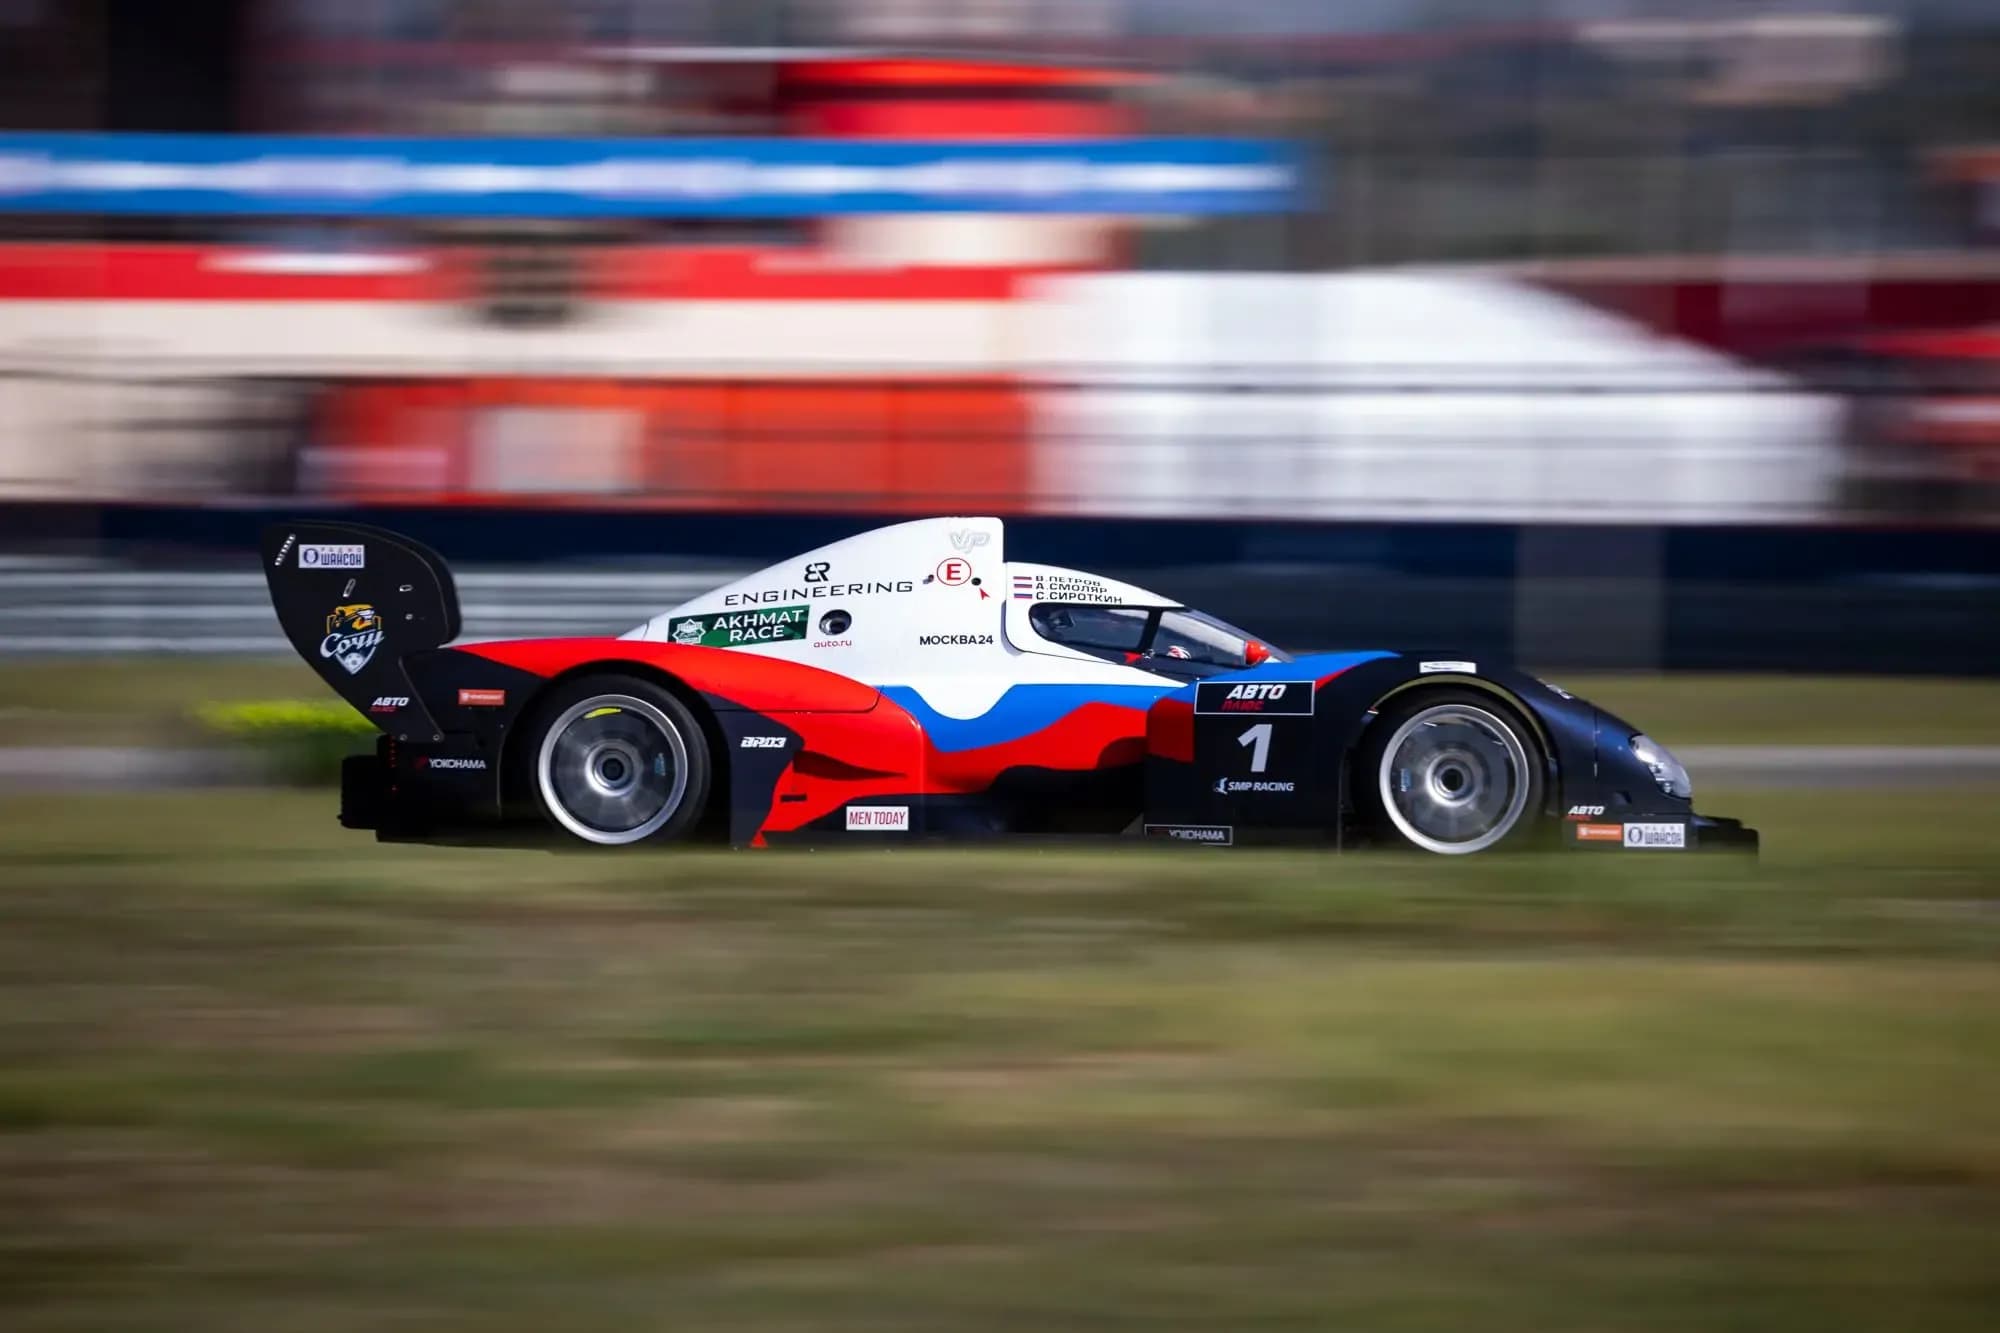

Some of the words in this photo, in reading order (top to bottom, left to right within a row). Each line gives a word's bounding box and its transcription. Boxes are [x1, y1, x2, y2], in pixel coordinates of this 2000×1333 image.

[321, 553, 362, 566] ШАНСОН
[946, 563, 962, 580] E
[725, 581, 913, 606] ENGINEERING
[1035, 583, 1108, 593] А.СМОЛЯР
[1035, 592, 1123, 604] С.СИРОТКИН
[713, 609, 804, 630] AKHMAT
[729, 625, 785, 642] RACE
[919, 635, 994, 645] МОСКВА24
[320, 630, 384, 658] Сочи
[813, 640, 852, 648] auto.ru
[1226, 684, 1287, 700] АВТО
[372, 697, 409, 706] АВТО
[1237, 724, 1273, 773] 1
[429, 758, 486, 769] YOKOHAMA
[1227, 782, 1252, 791] SMP
[1253, 782, 1295, 792] RACING
[1568, 806, 1605, 815] АВТО
[849, 812, 871, 825] MEN
[874, 812, 906, 825] TODAY
